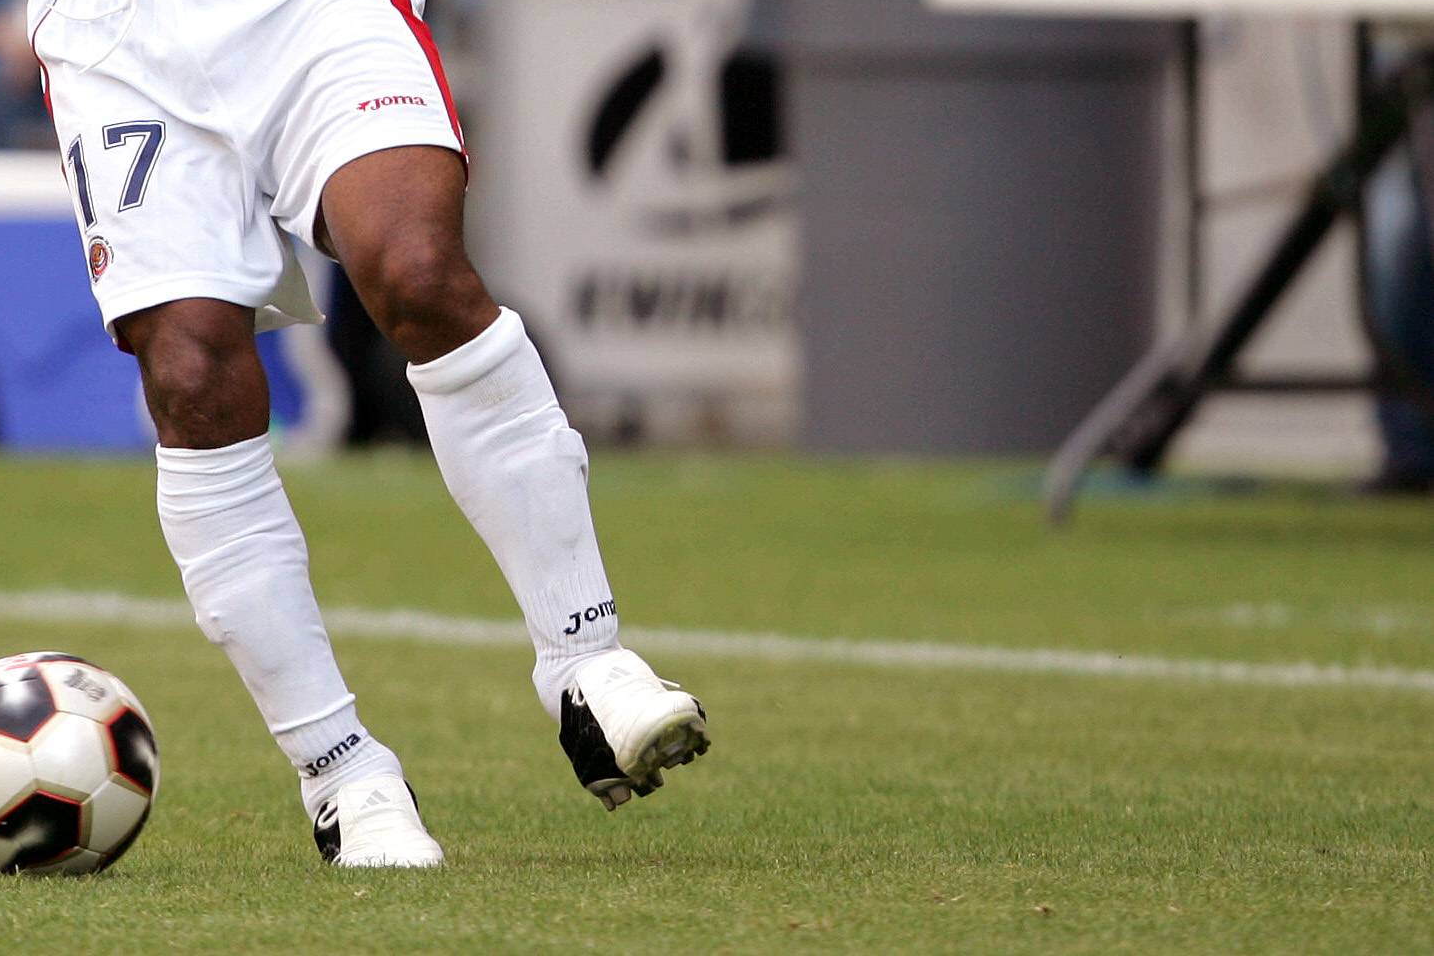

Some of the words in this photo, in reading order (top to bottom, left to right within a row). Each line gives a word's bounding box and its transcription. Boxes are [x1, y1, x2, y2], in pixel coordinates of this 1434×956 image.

[370, 95, 428, 111] Joma
[67, 120, 166, 234] 17
[306, 733, 362, 776] Joma
